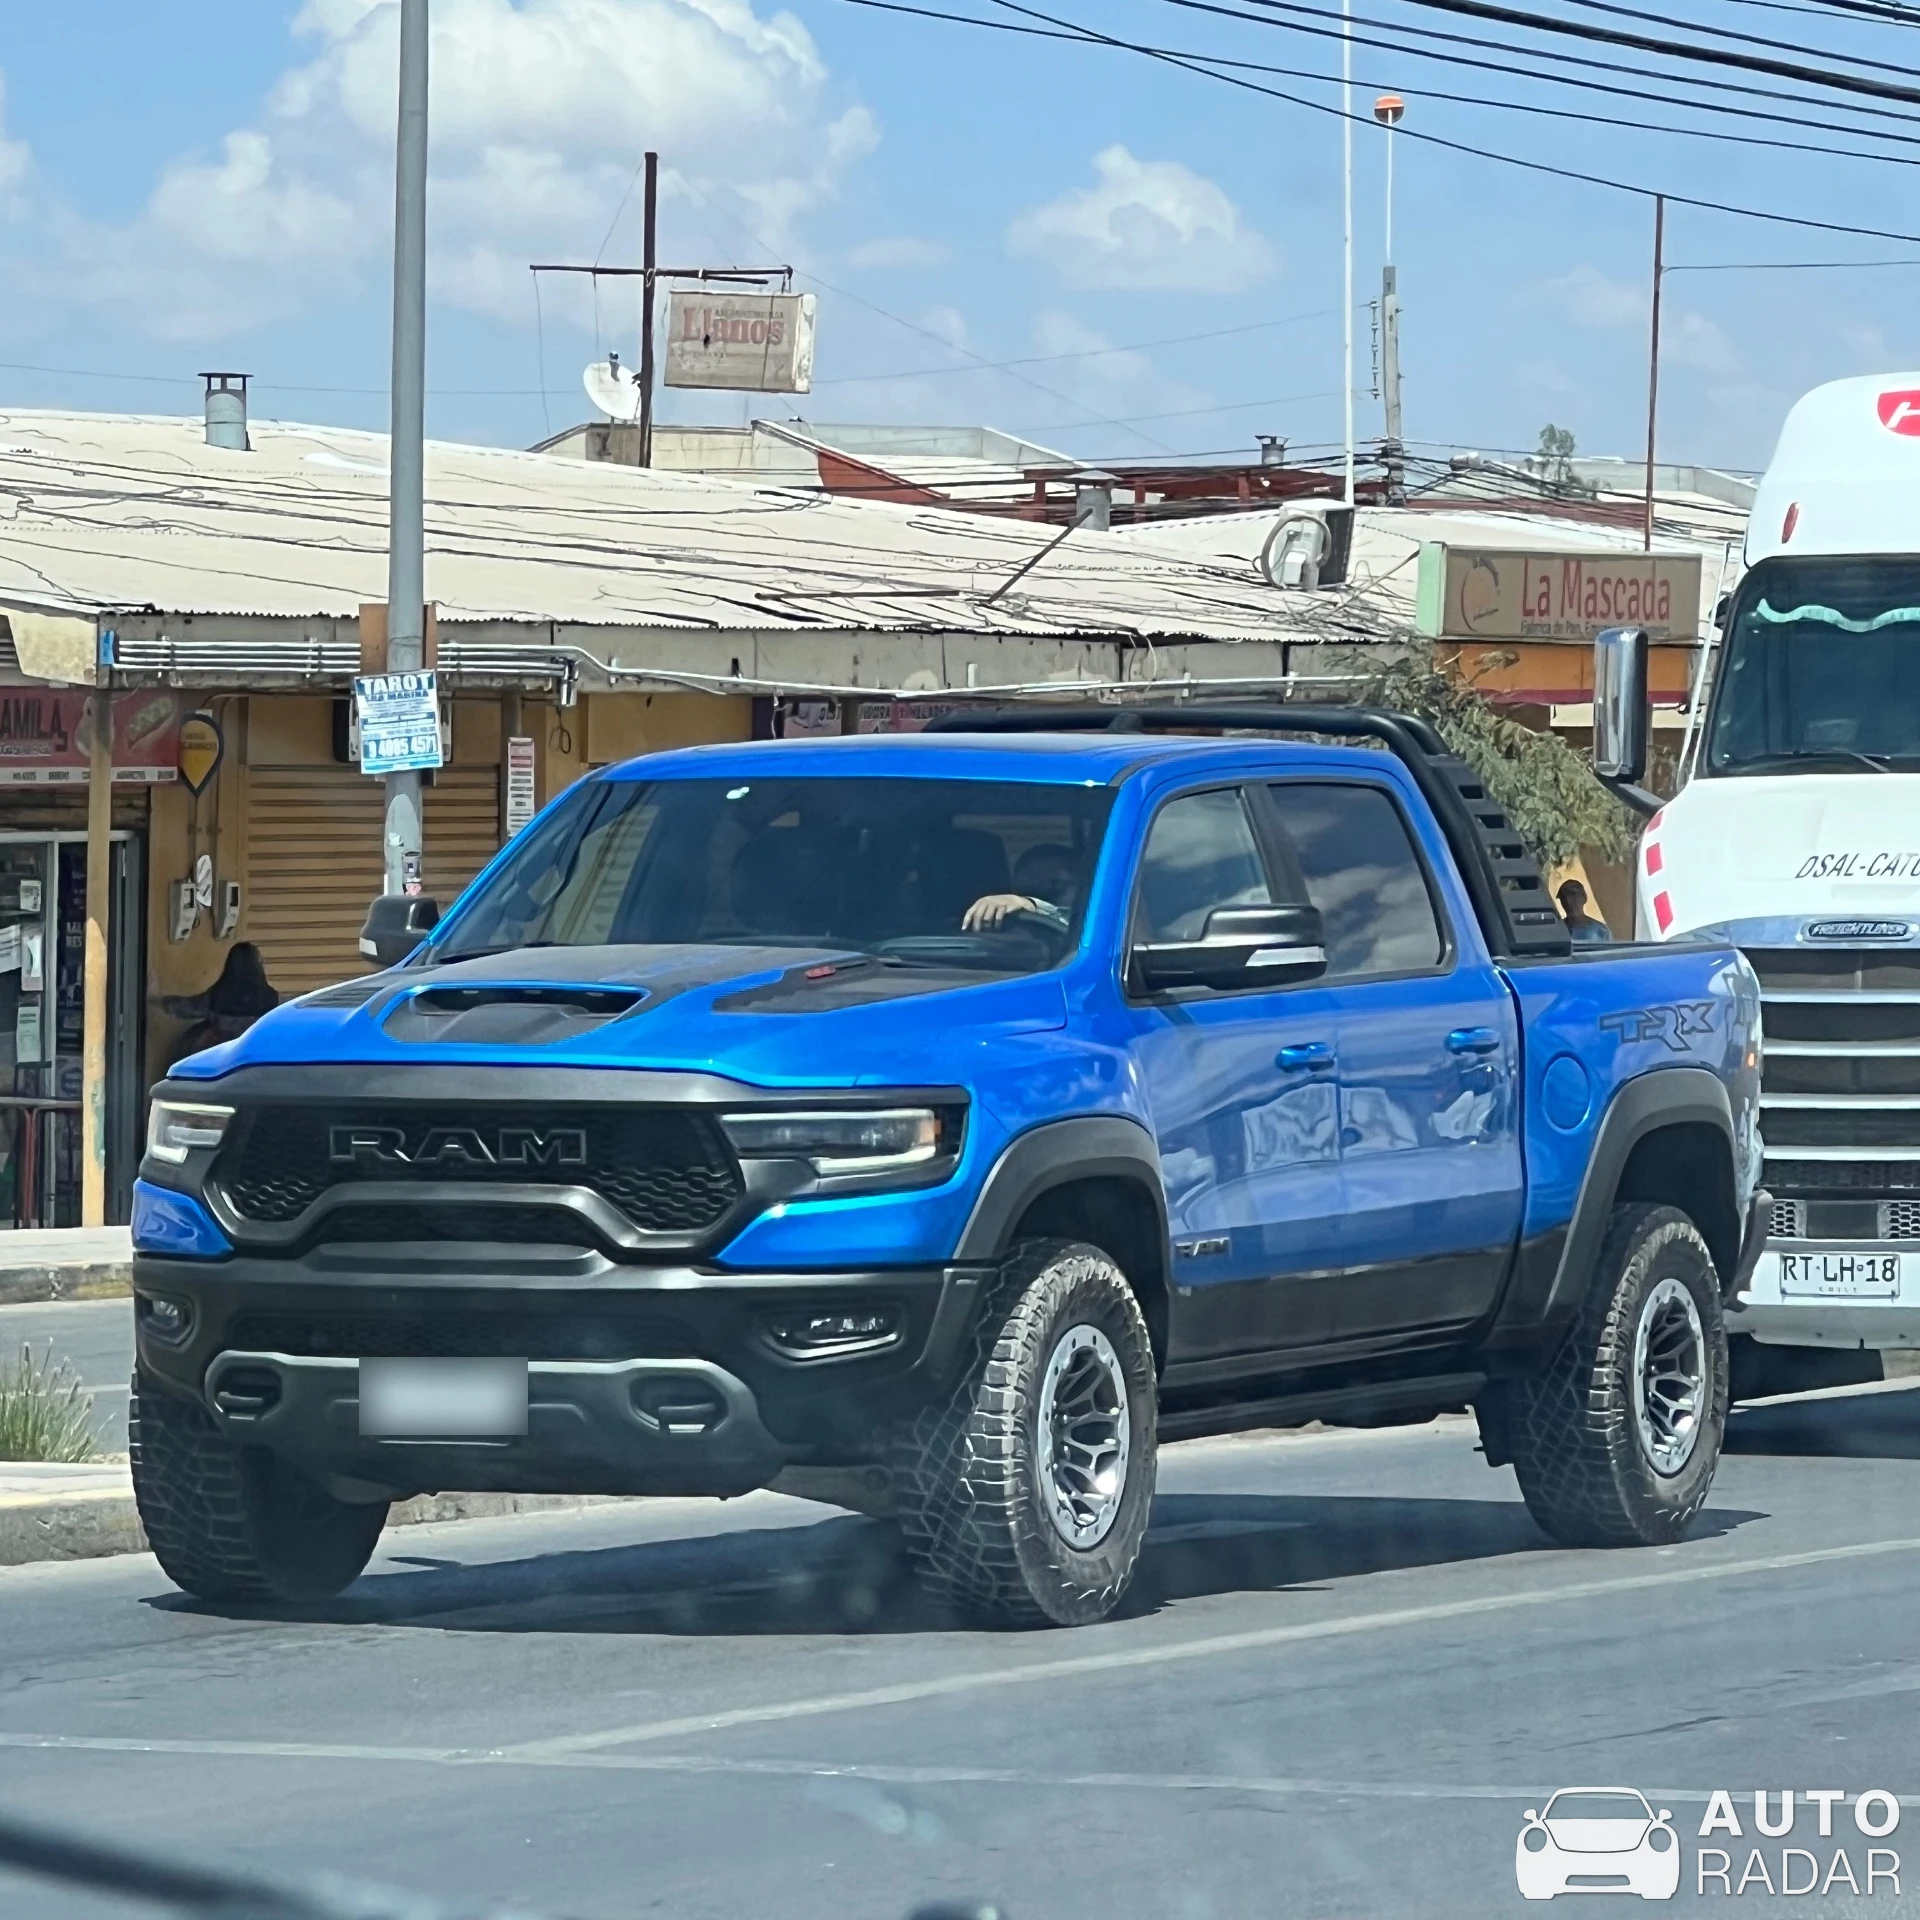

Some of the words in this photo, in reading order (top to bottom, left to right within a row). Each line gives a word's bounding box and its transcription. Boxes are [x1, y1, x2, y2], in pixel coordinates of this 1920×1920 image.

[682, 307, 785, 346] Llanos
[1522, 556, 1551, 618] La
[1560, 558, 1671, 622] Mascada
[360, 673, 432, 695] TAROT
[1600, 1002, 1715, 1051] TRX
[330, 1126, 586, 1164] RAM
